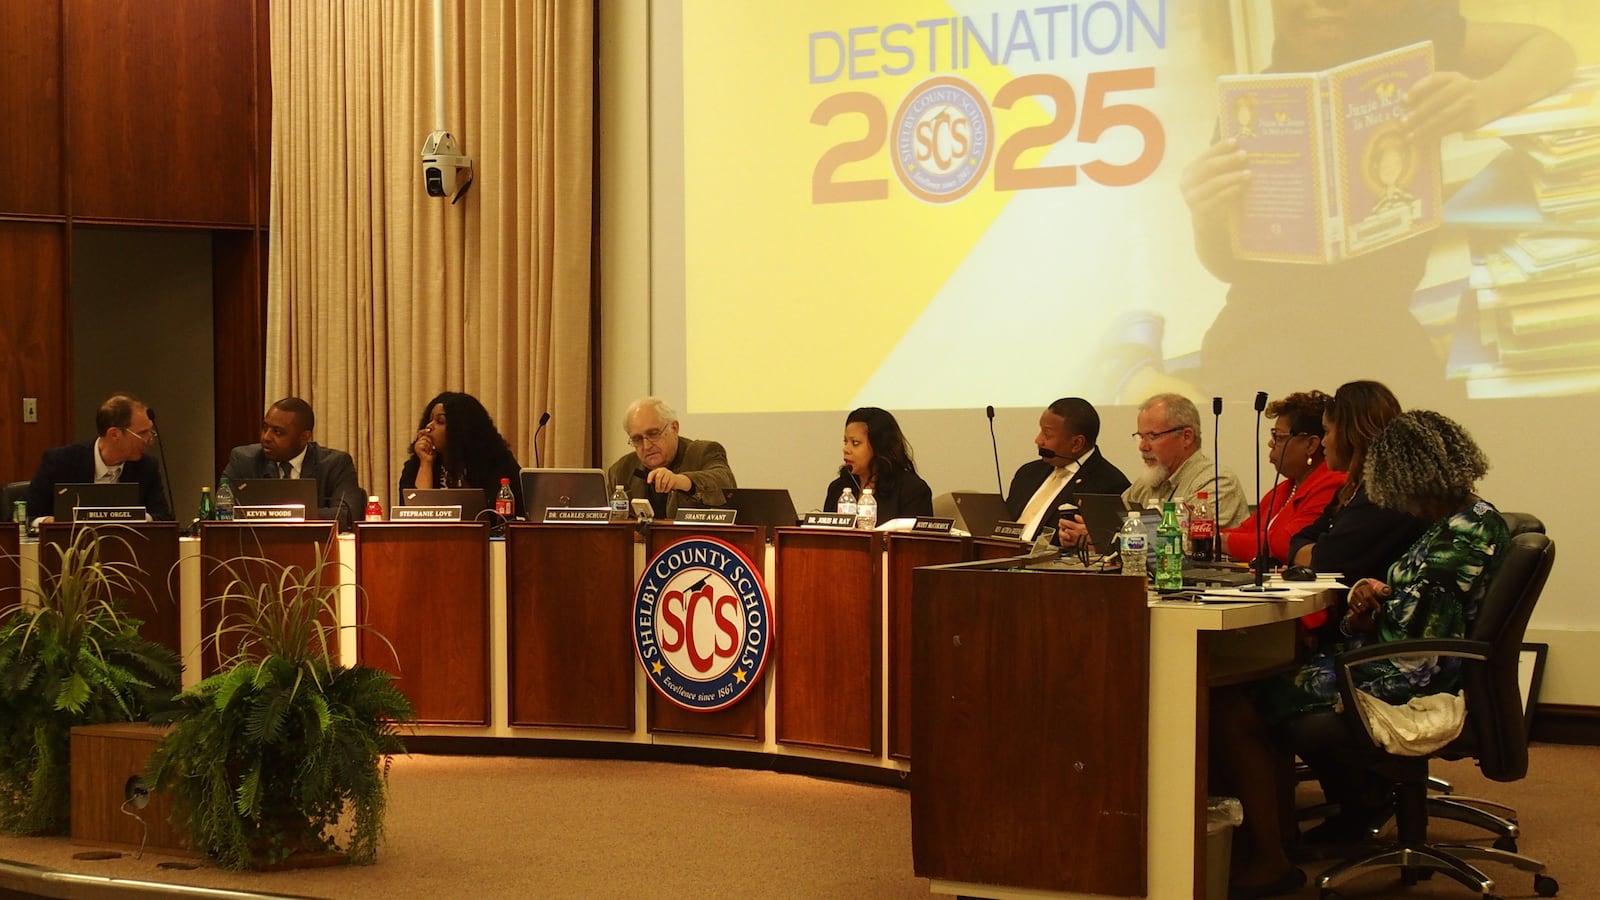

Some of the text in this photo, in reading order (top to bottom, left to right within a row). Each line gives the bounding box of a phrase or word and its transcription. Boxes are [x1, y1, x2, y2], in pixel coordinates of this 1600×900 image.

[809, 0, 1166, 84] DESTINATION
[913, 90, 958, 113] COUNTY
[962, 98, 983, 155] SCHOOLS
[916, 111, 969, 171] SCS
[640, 548, 763, 669] SHELBY COUNTY SCHOOLS
[661, 584, 740, 673] SCS
[663, 676, 735, 701] Excellence since 1867
